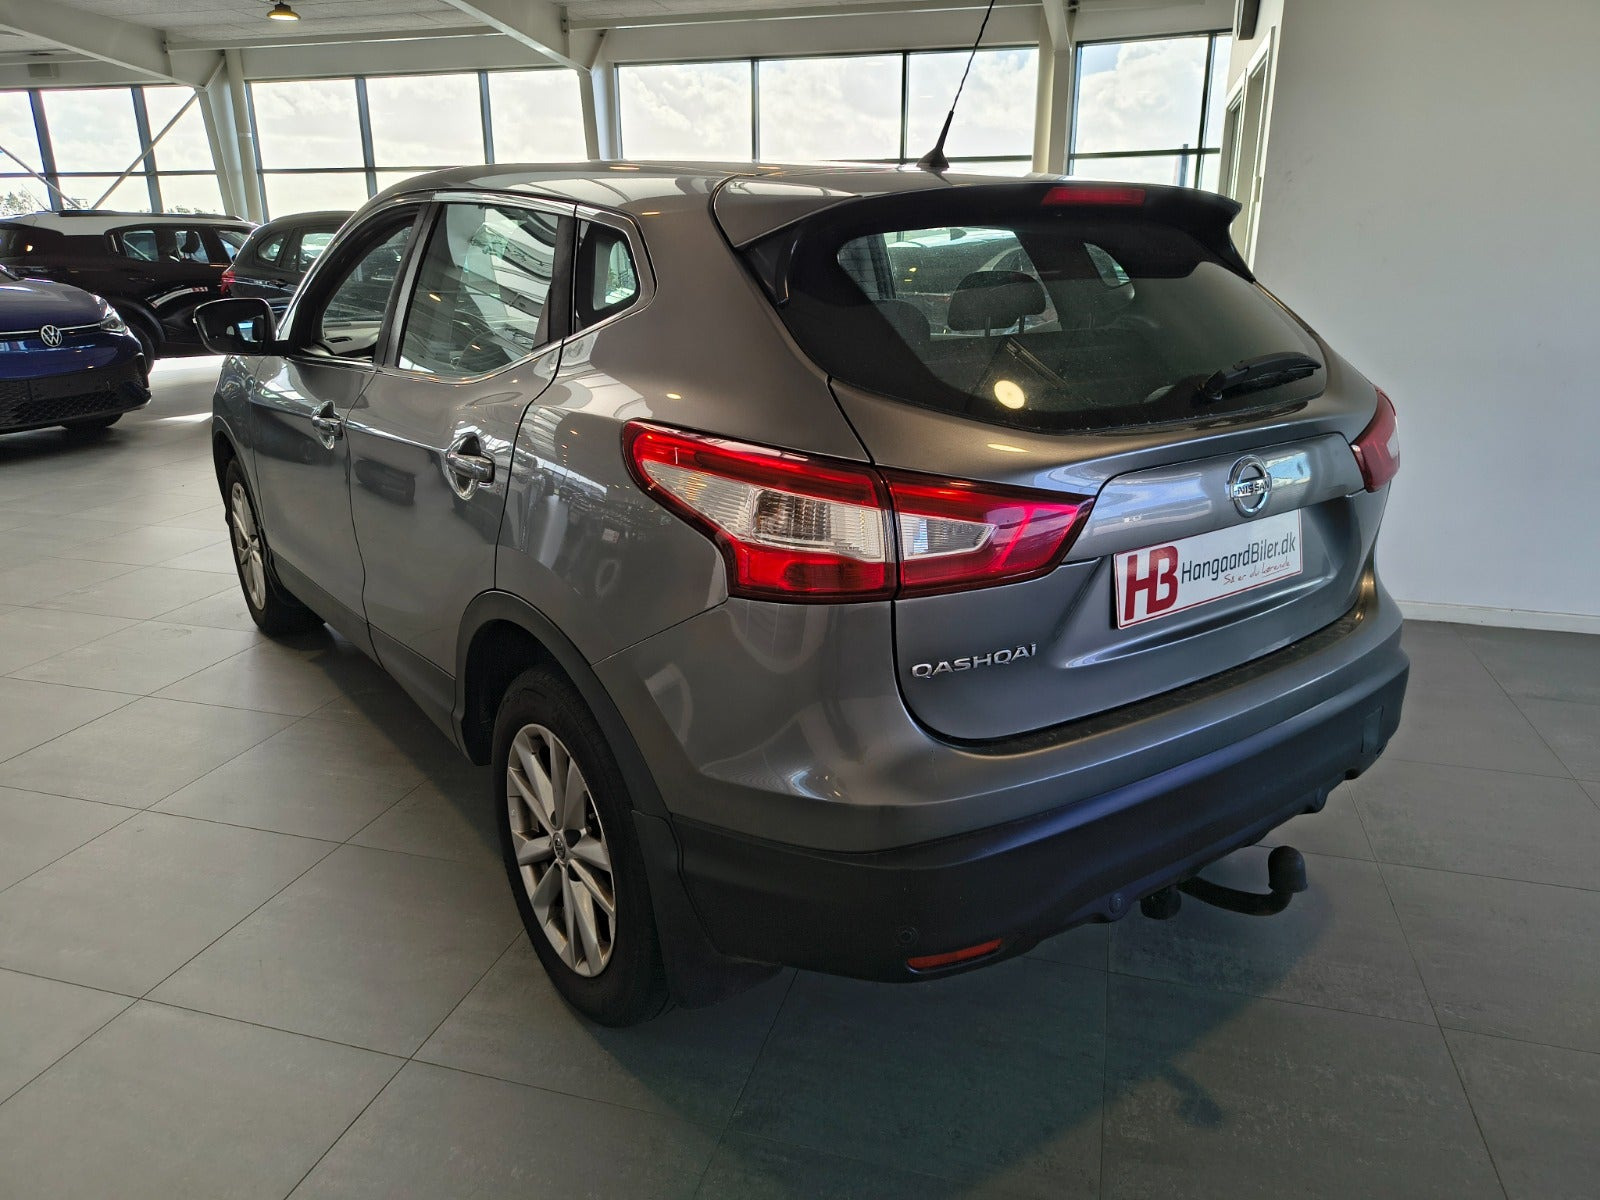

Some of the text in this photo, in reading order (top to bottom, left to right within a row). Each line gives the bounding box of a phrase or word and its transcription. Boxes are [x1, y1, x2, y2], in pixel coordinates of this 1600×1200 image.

[1237, 481, 1270, 494] NISSAN
[1124, 545, 1178, 621] HB
[1181, 532, 1296, 584] HangaardBiler.dk
